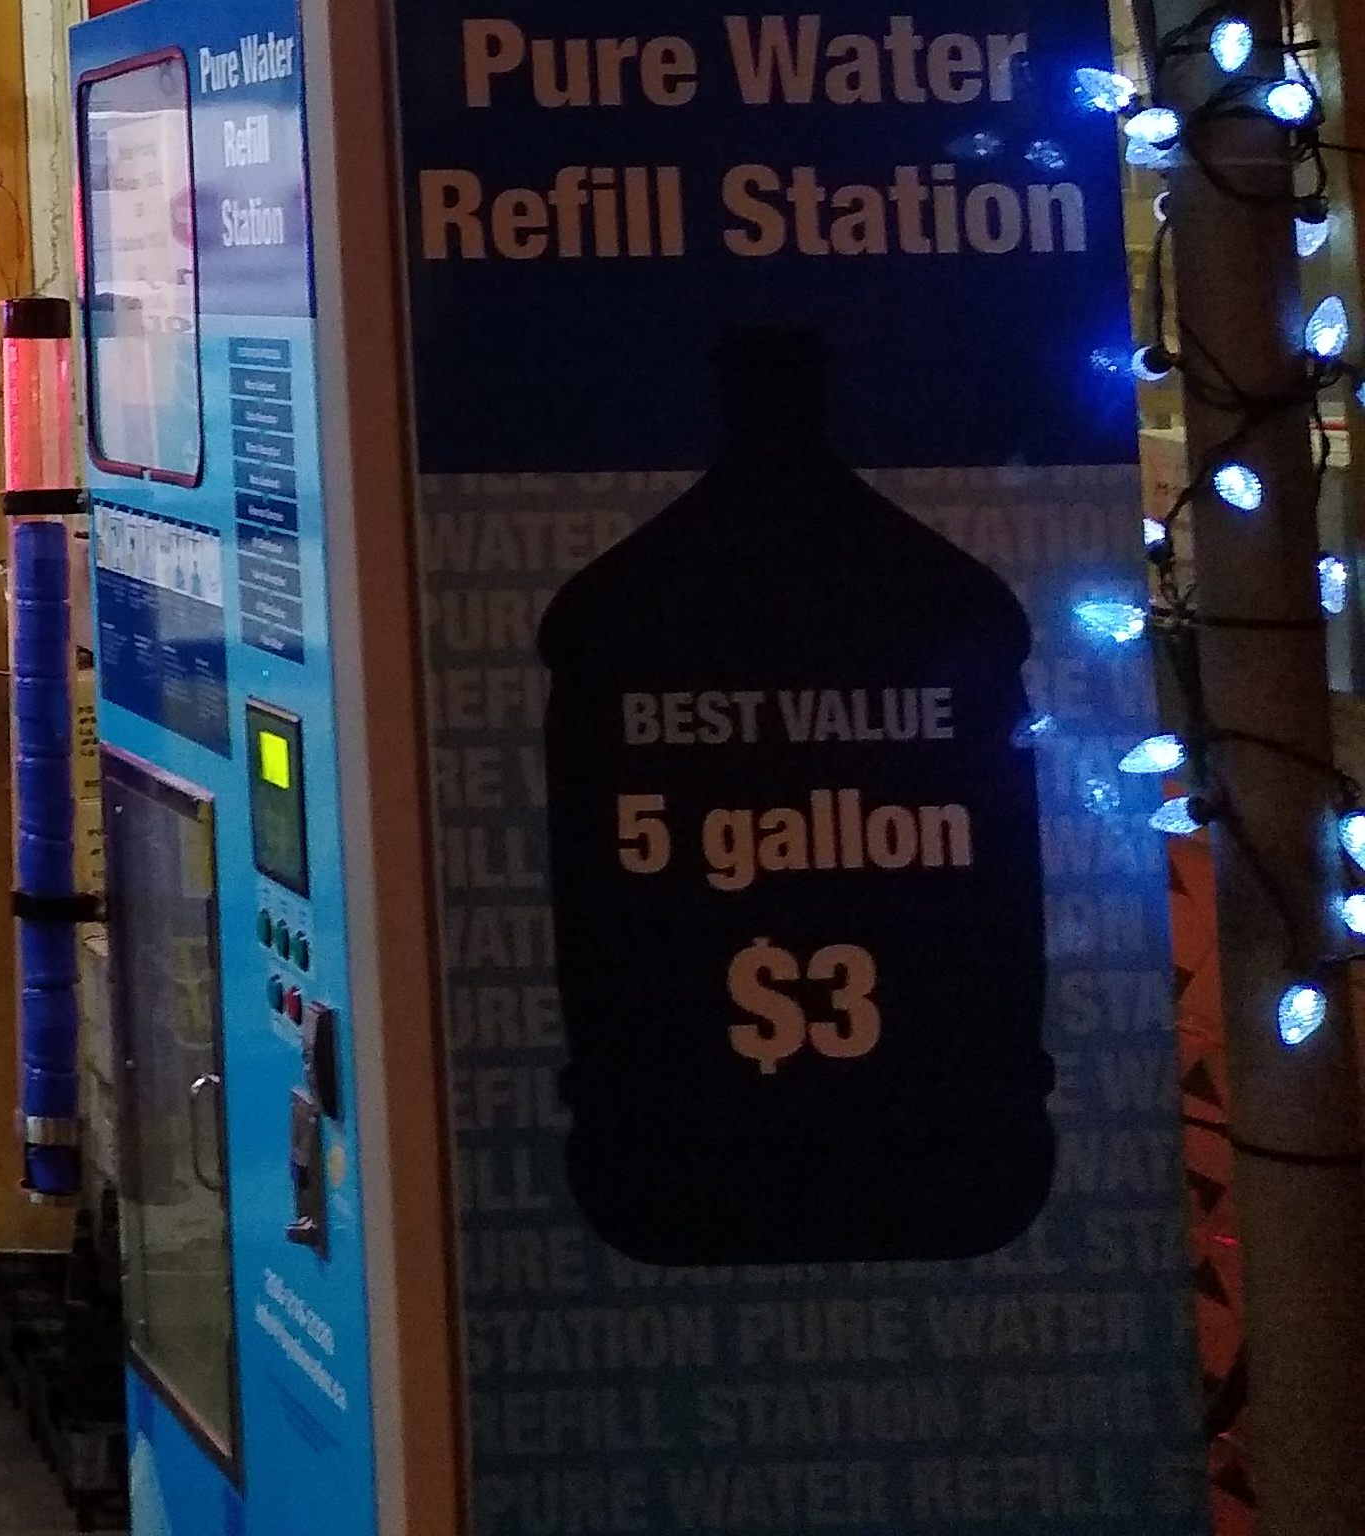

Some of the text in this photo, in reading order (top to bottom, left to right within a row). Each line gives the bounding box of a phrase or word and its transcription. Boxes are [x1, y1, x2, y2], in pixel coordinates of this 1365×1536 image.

[198, 30, 295, 96] Pure Water
[461, 14, 1029, 109] Pure Water
[222, 119, 271, 169] Refill
[220, 202, 286, 249] Station
[417, 163, 1088, 261] Refill Station
[621, 686, 955, 745] BEST VALUE
[615, 794, 670, 874] 5
[700, 788, 974, 892] gallon
[726, 935, 884, 1075] $3
